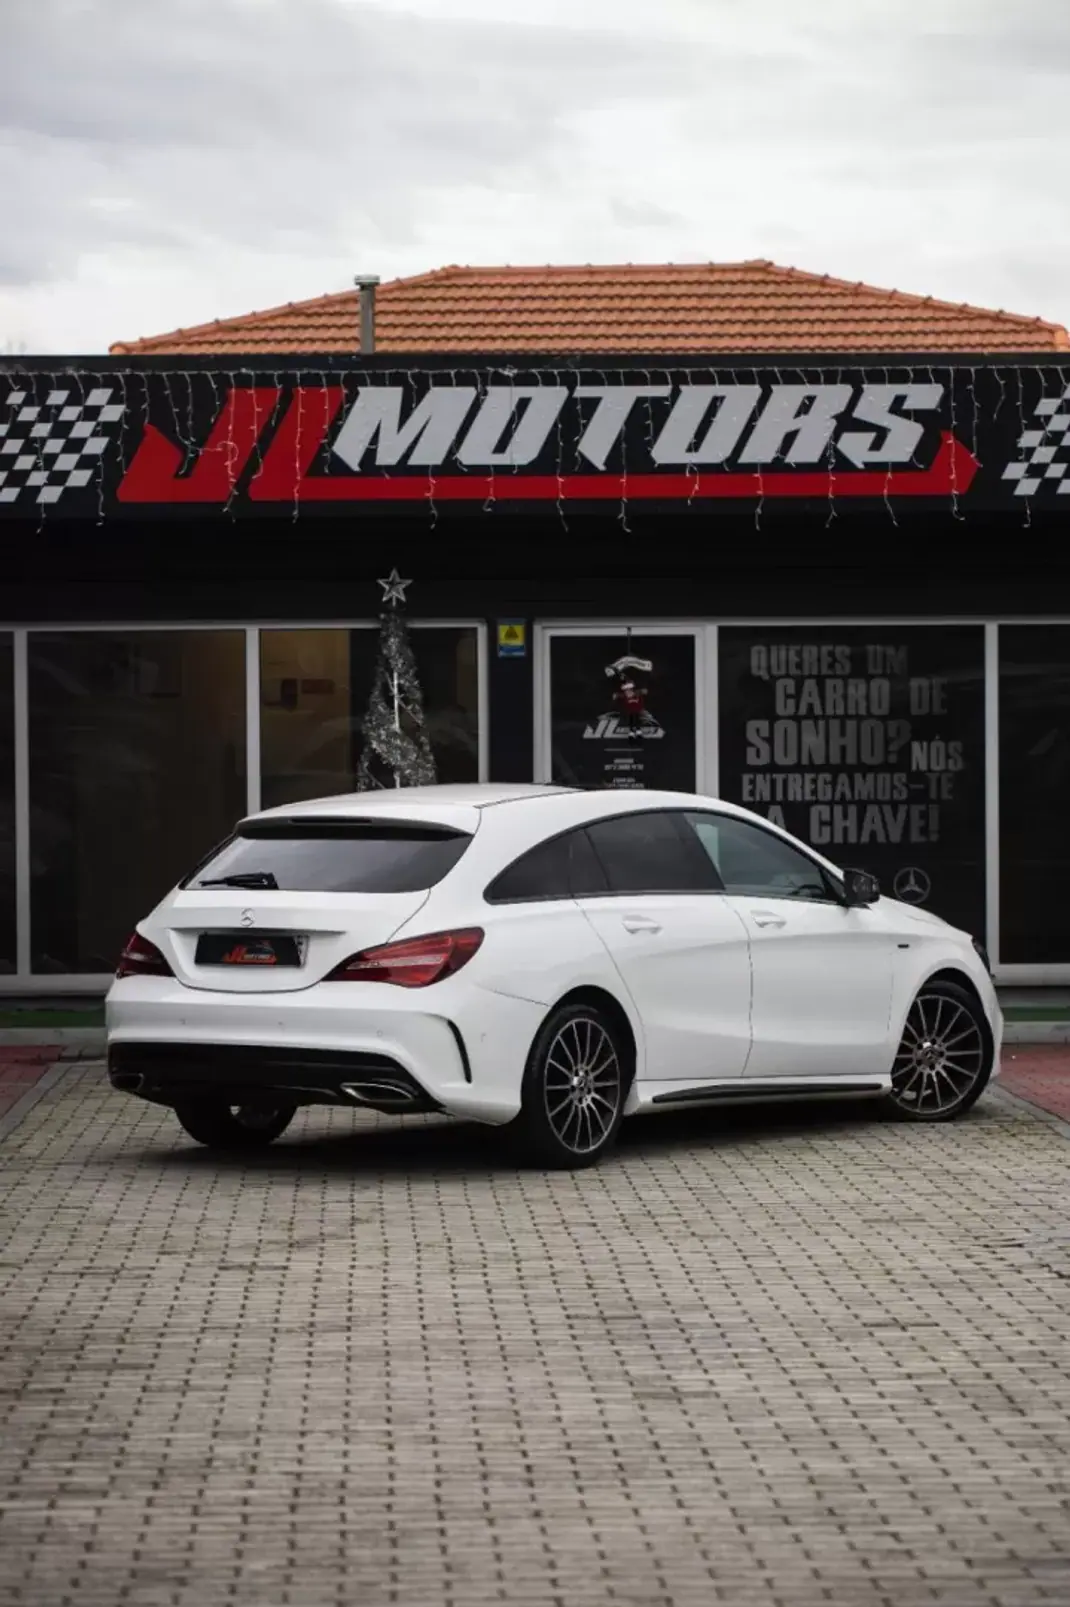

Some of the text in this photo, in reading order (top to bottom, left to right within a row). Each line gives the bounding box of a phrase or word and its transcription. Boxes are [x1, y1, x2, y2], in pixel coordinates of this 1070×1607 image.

[332, 384, 944, 472] MOTORS
[750, 643, 909, 680] QUERES UM
[775, 677, 948, 716] CARRO DE
[745, 718, 964, 771] SONHO? NÓS
[741, 772, 954, 802] ENTREGAMOS-TE
[809, 804, 940, 844] CHAVE!
